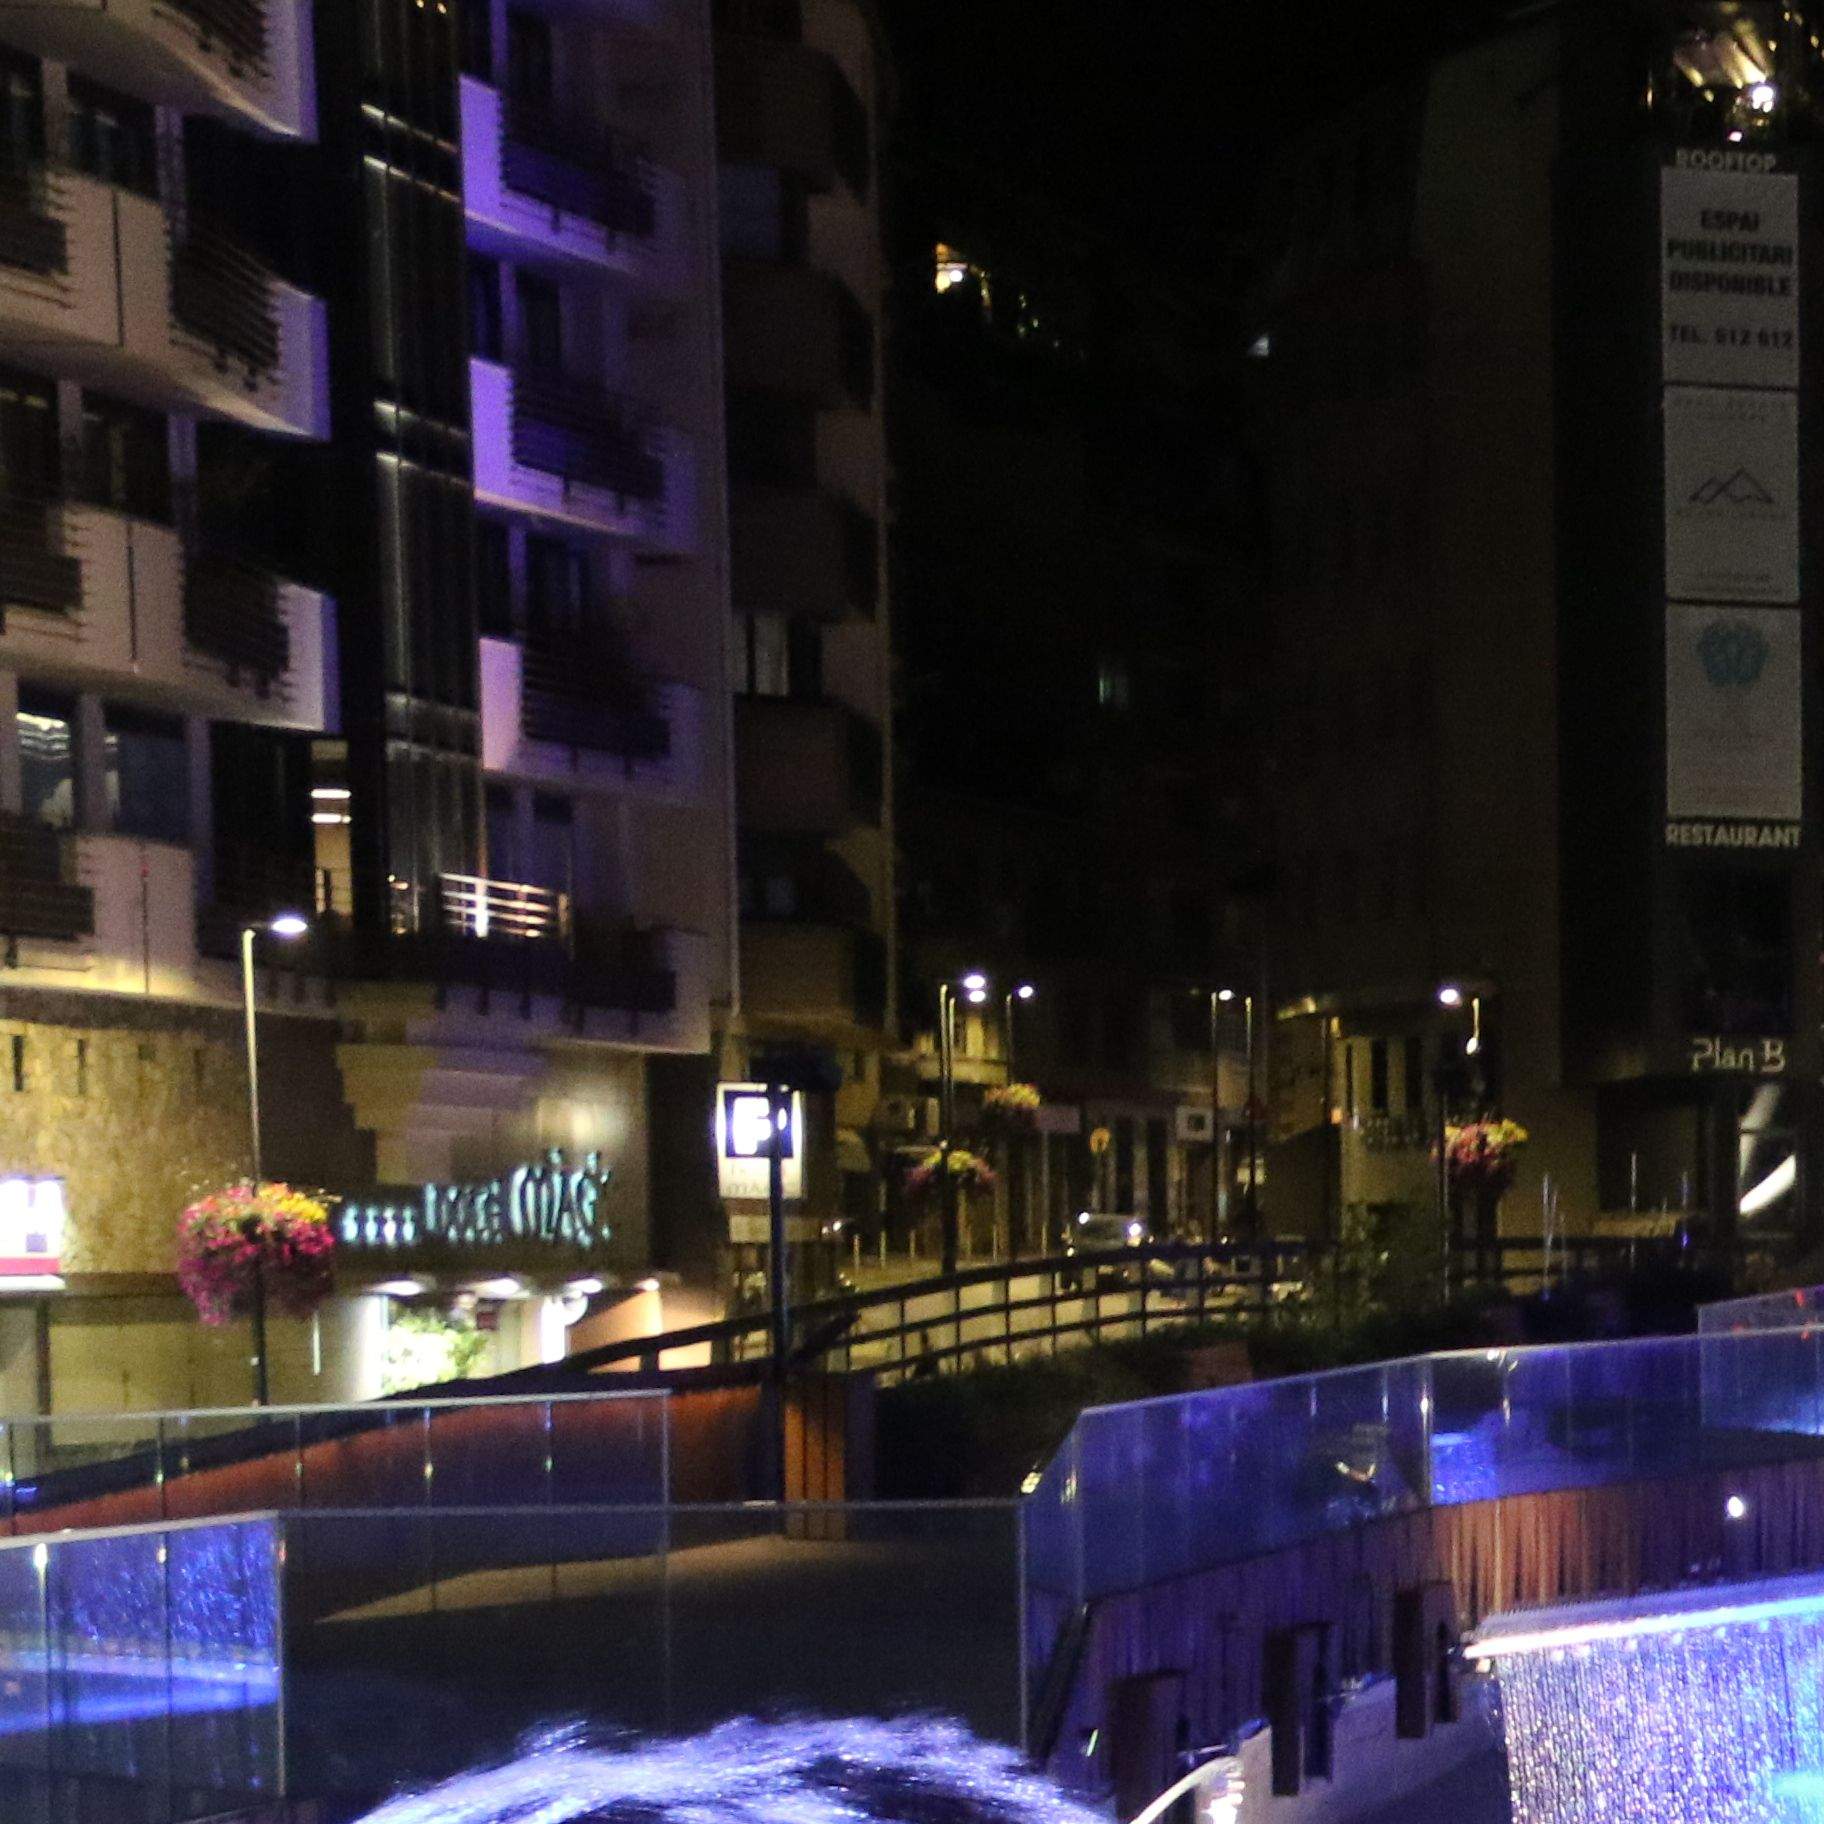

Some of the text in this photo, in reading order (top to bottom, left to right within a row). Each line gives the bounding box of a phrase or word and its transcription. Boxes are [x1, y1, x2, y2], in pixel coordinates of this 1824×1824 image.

[1700, 209, 1760, 231] ESPAI
[1667, 238, 1793, 266] PUBLICITARI
[1669, 270, 1791, 297] DISPONIBLE
[1664, 823, 1801, 848] RESTAURANT
[1690, 1036, 1787, 1074] Plan B
